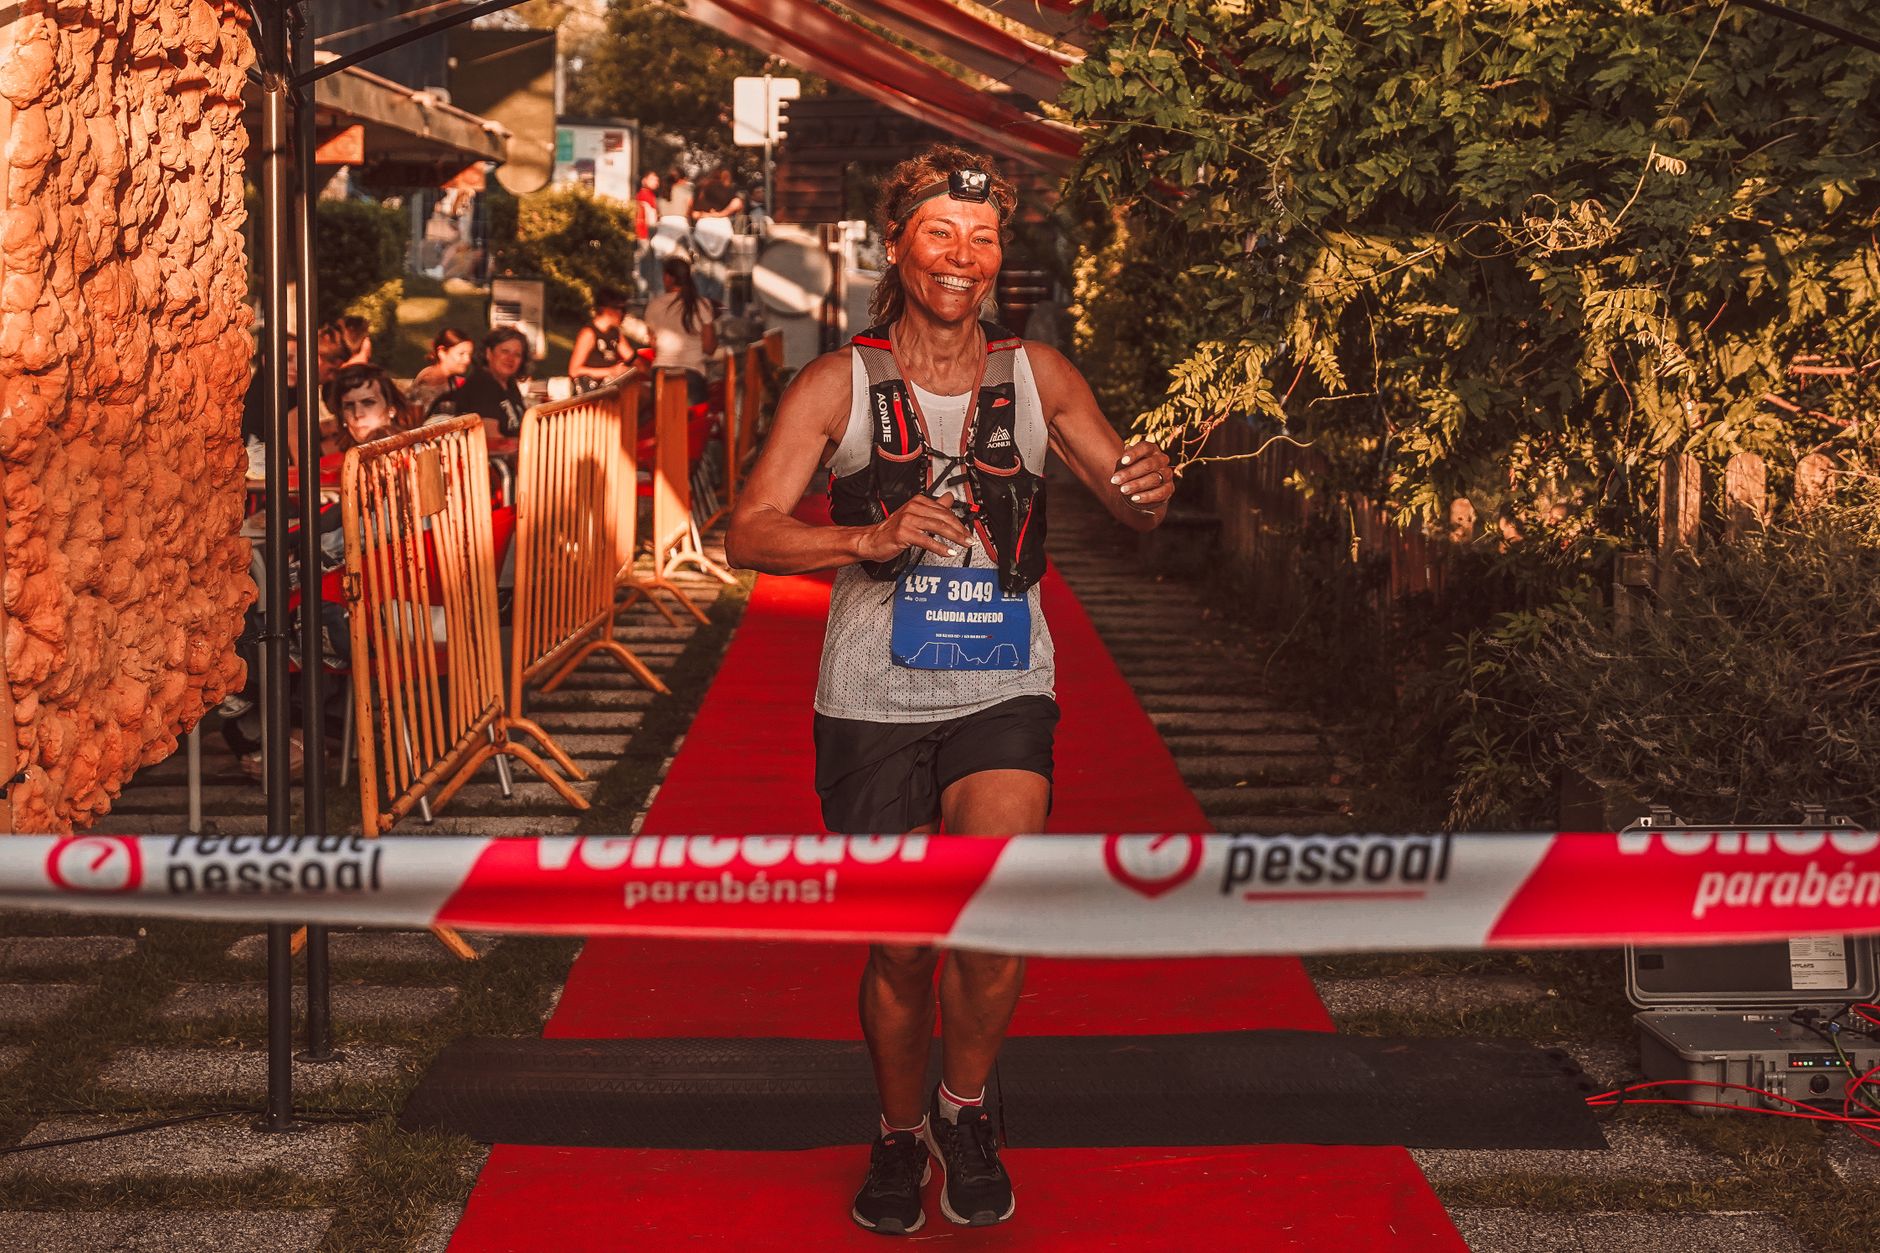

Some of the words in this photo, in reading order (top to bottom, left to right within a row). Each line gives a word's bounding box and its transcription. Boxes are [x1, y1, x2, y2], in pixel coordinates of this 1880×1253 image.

[876, 392, 892, 443] AONIJIE
[947, 580, 994, 602] 3049
[925, 609, 966, 623] CLÁUDIA
[966, 612, 1004, 623] AZEVEDO
[167, 846, 382, 894] pessoal
[1221, 834, 1454, 896] pessoal
[624, 869, 837, 909] parabéns!
